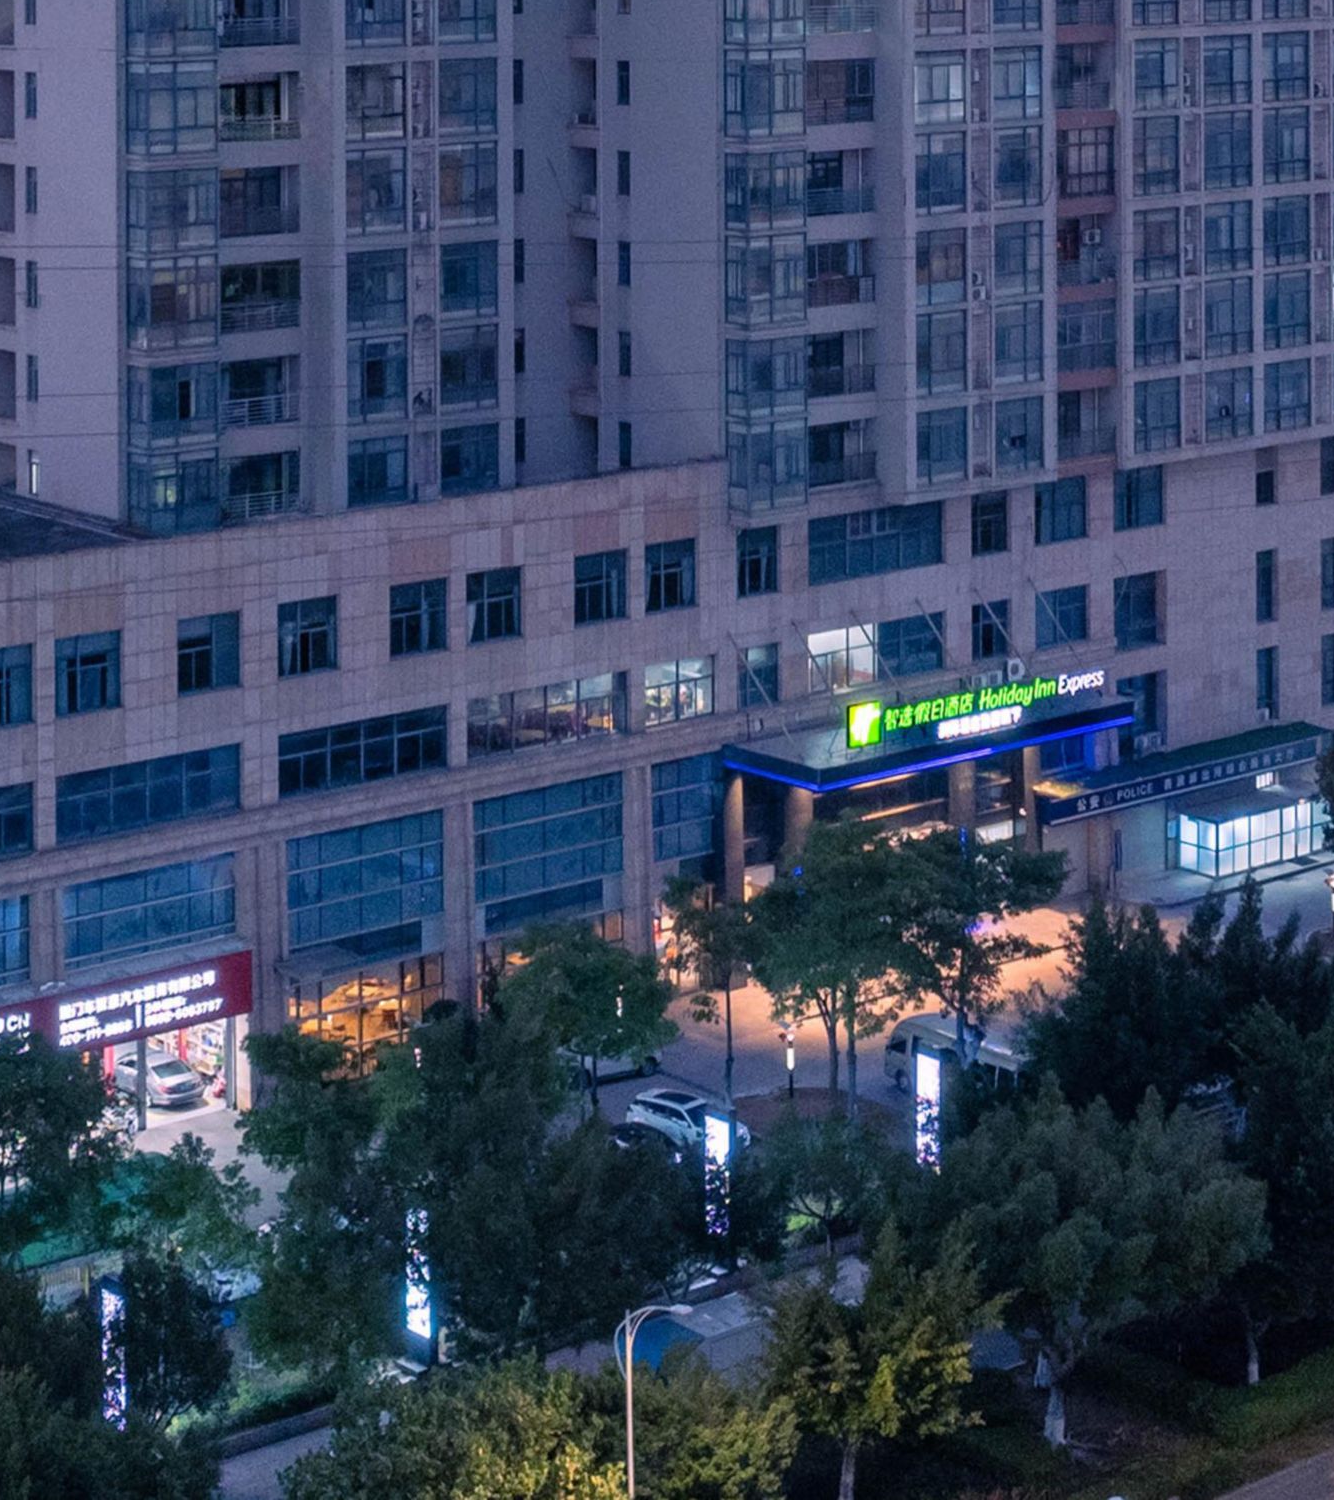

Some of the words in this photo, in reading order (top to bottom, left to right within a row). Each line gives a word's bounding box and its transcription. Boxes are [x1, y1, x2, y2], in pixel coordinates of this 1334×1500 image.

[978, 680, 1034, 711] Holiday
[1034, 677, 1057, 699] Inn
[1057, 670, 1105, 696] Express
[1116, 783, 1154, 802] POLICE
[1076, 795, 1101, 813] 公安
